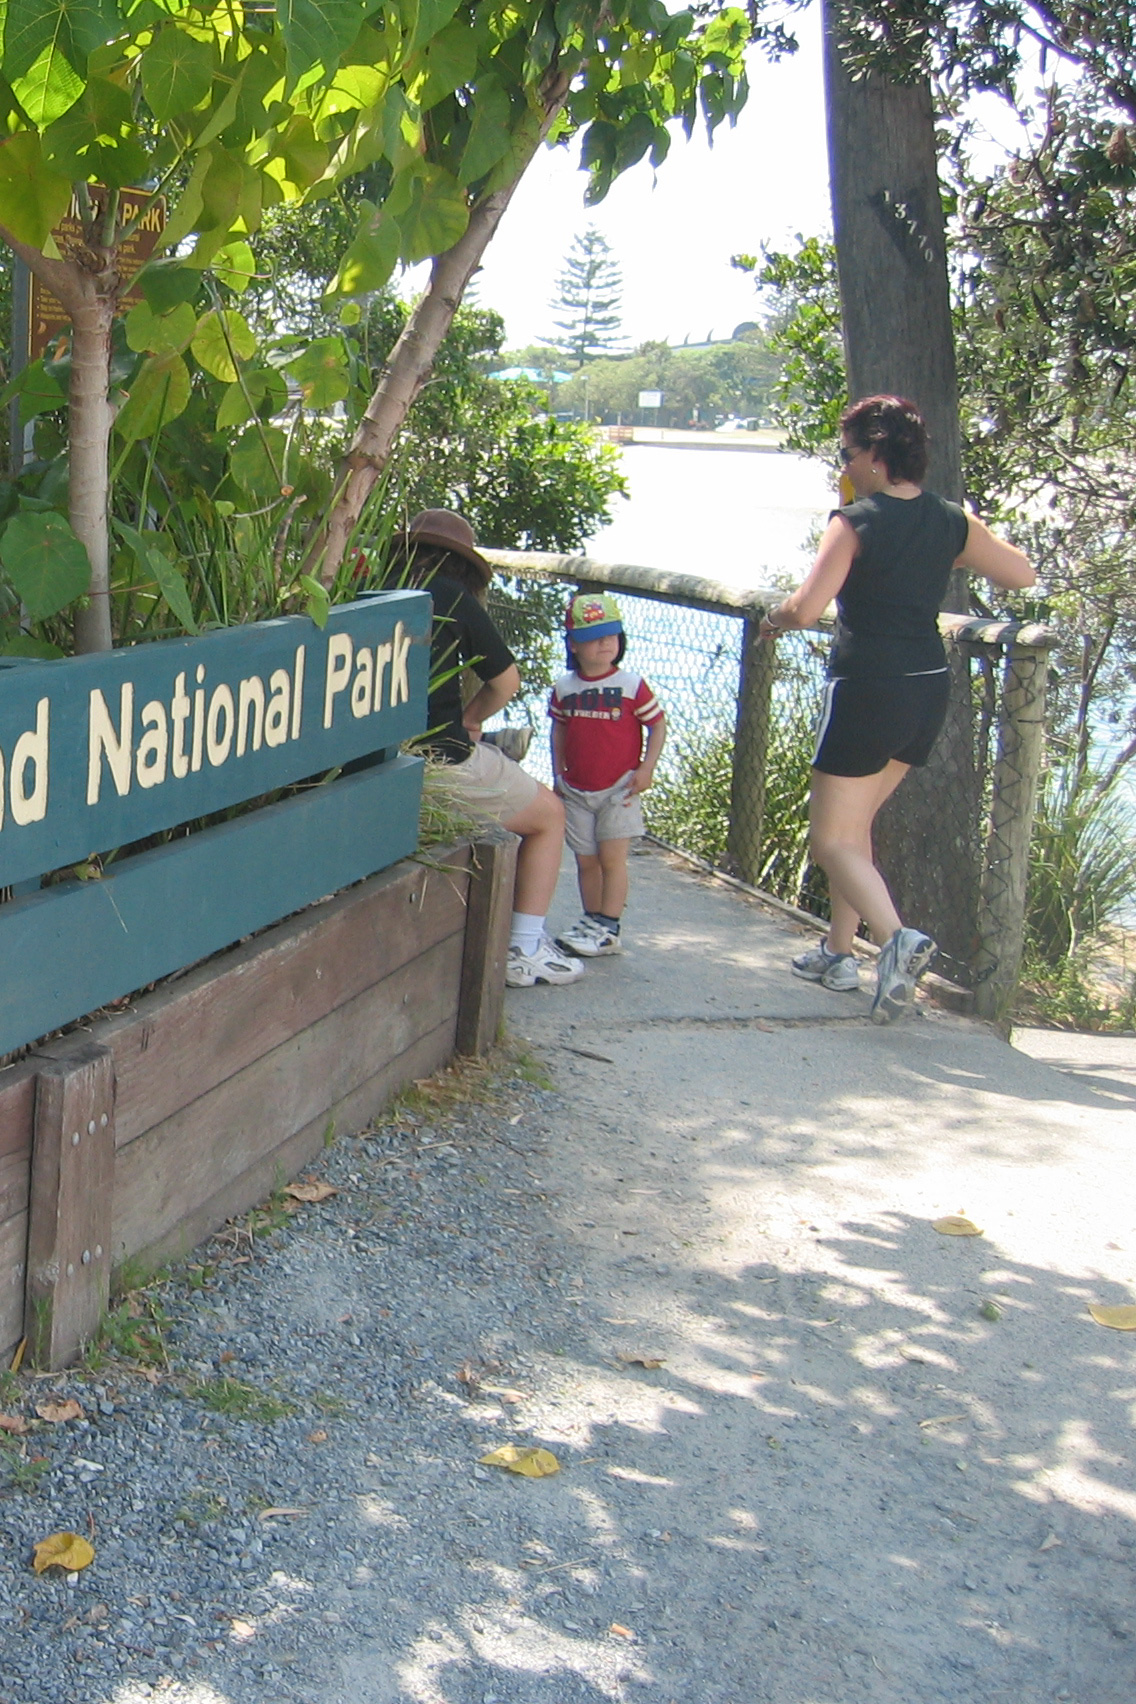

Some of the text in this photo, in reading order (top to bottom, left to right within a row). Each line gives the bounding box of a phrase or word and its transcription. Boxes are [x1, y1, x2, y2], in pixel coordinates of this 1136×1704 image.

[122, 203, 161, 233] PARK
[884, 190, 933, 262] 13770
[86, 645, 305, 804] National
[323, 620, 411, 729] Park
